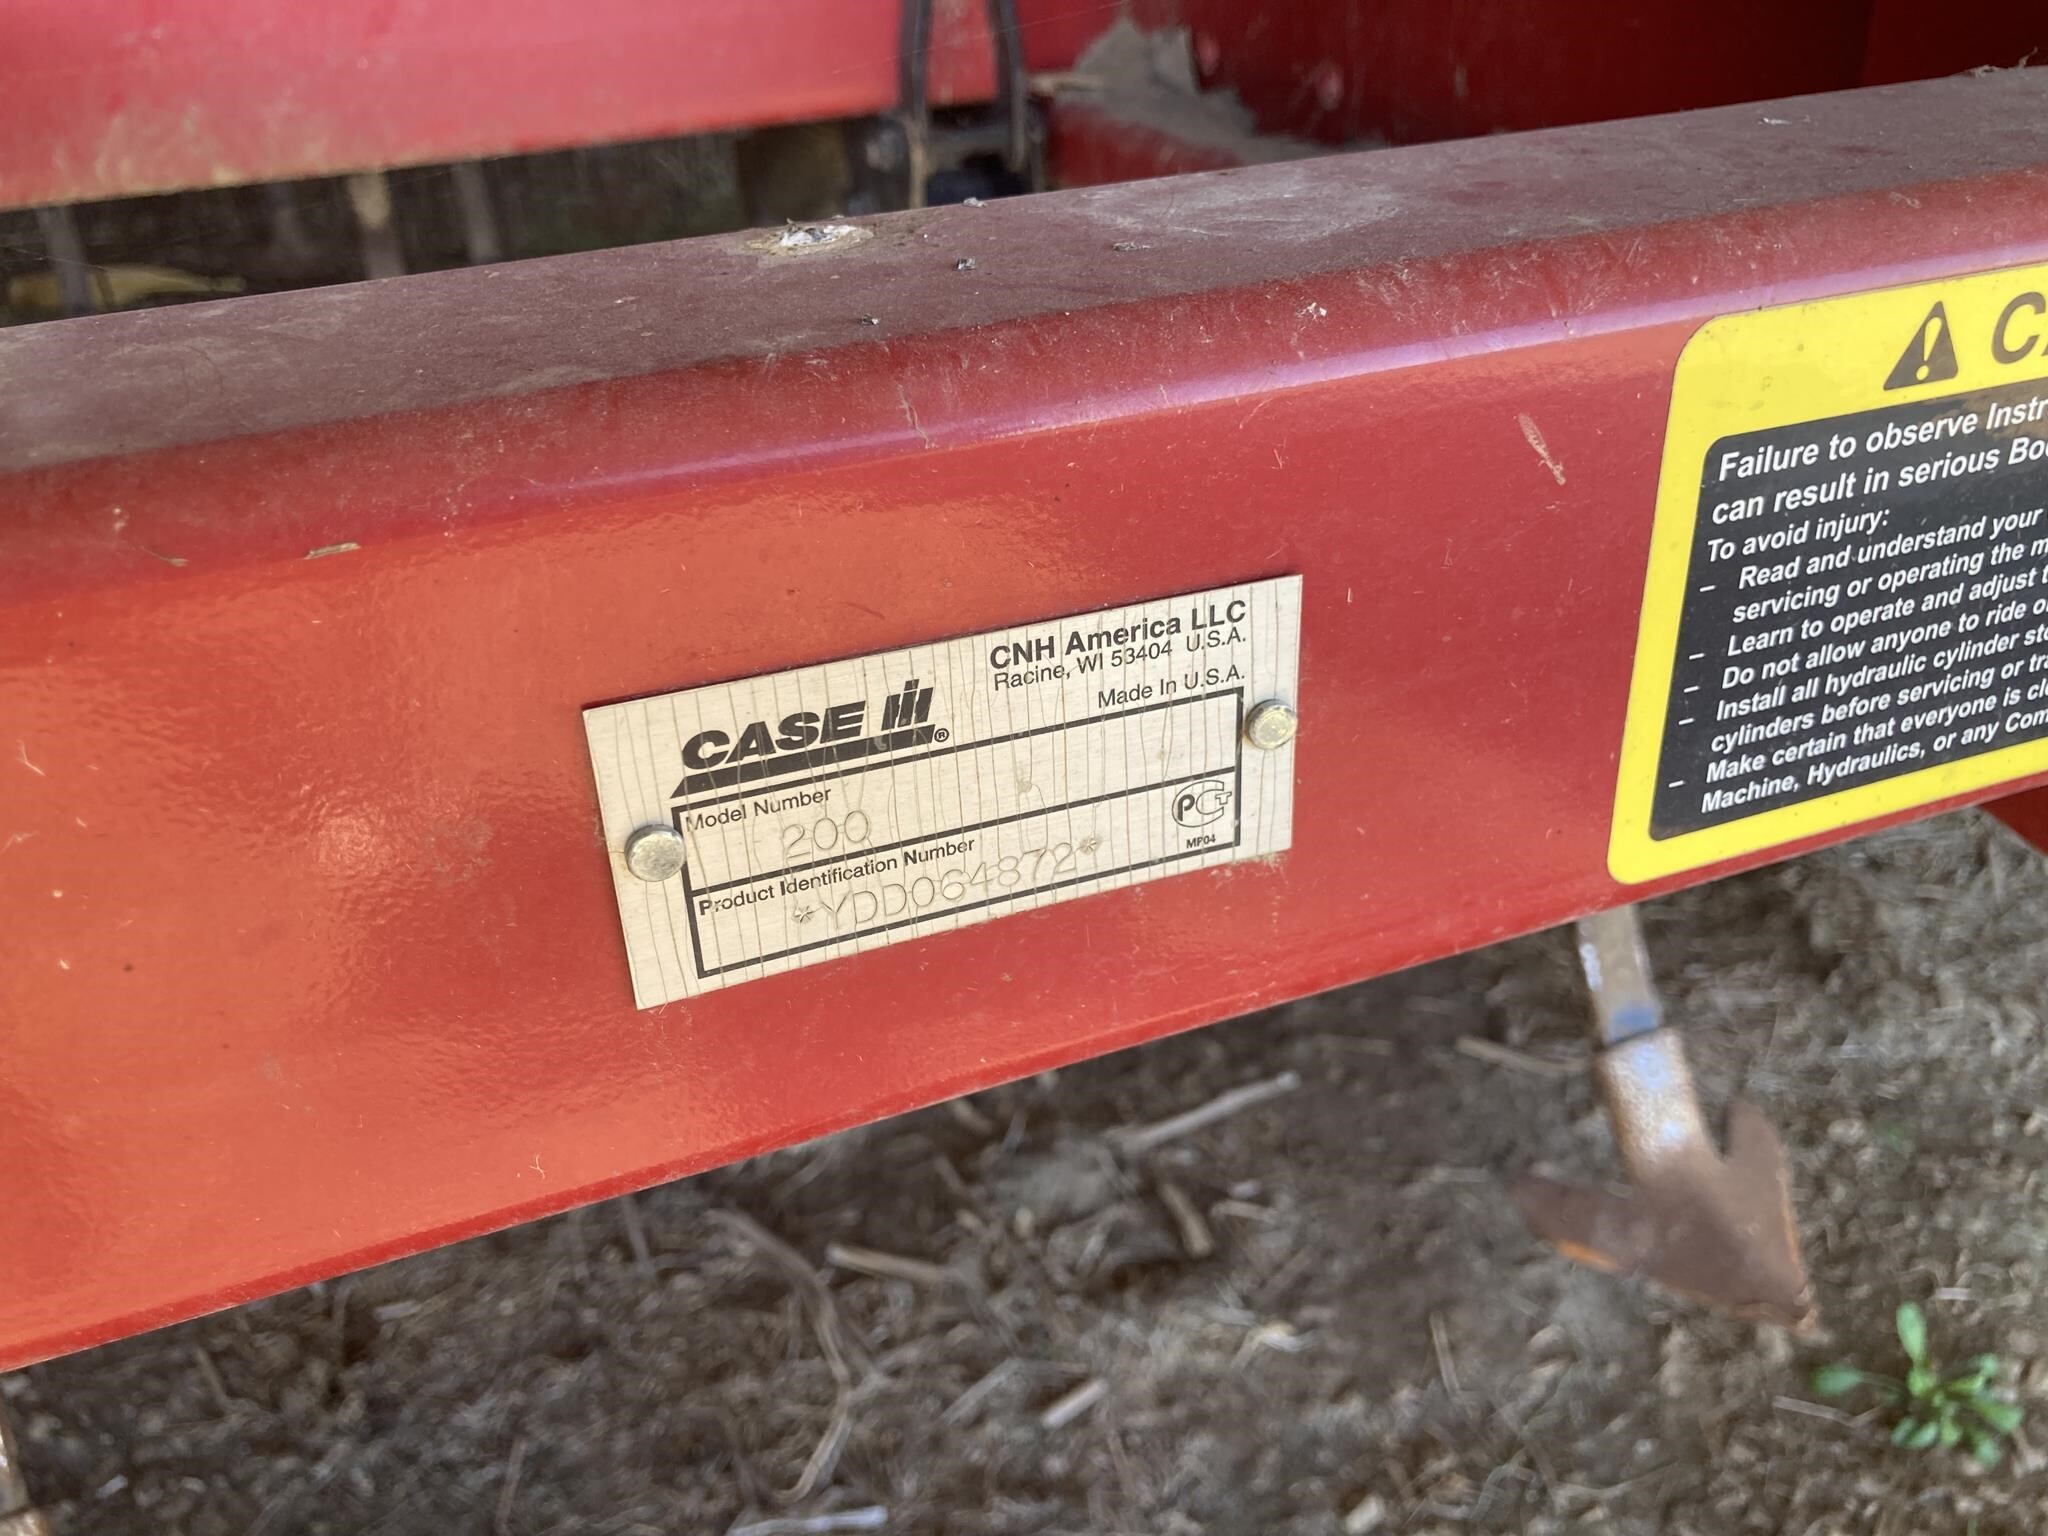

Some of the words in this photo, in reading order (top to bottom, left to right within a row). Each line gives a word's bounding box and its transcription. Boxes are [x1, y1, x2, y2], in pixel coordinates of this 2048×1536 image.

[1992, 292, 2048, 364] C
[1712, 495, 1764, 525] can
[1773, 470, 1855, 513] result
[1864, 467, 1889, 495] in
[1898, 448, 2000, 487] serious
[2008, 437, 2048, 465] Bo
[1719, 443, 1819, 481] Failure
[1828, 434, 1856, 460] to
[1866, 413, 1978, 452] observe
[1707, 538, 1735, 562] To
[1742, 520, 1810, 556] avoid
[1815, 508, 1890, 542] injury:
[1739, 555, 1801, 589] Read
[1806, 544, 1851, 575] and
[1857, 515, 1987, 563] understand
[1989, 508, 2044, 540] your
[1727, 626, 1793, 658] Learn
[1800, 618, 1823, 640] to
[1830, 597, 1915, 635] operate
[1921, 582, 1964, 612] and
[1968, 567, 2037, 601] adjust
[1732, 583, 1840, 624] servicing
[1846, 576, 1873, 598] or
[1877, 552, 1984, 593] operating
[1990, 542, 2025, 565] the
[990, 636, 1055, 670] CNH
[1065, 615, 1181, 656] America
[1192, 599, 1247, 631] LLC
[994, 664, 1071, 691] Racine,
[1077, 654, 1104, 675] WI
[1111, 640, 1173, 667] 53404
[1186, 627, 1247, 652] U.S.A.
[1721, 665, 1755, 689] Do
[1761, 652, 1801, 680] not
[1805, 640, 1866, 669] allow
[1870, 620, 1951, 653] anyone
[1958, 613, 1980, 633] to
[1985, 600, 2027, 627] ride
[2032, 598, 2048, 615] o
[1098, 680, 1153, 709] Made
[1160, 678, 1177, 695] In
[1184, 664, 1245, 690] U.S.A.
[1711, 712, 1815, 755] cylinders
[1821, 693, 1891, 725] before
[1897, 667, 1995, 705] servicing
[2001, 660, 2024, 680] or
[1716, 684, 1788, 721] Install
[1791, 676, 1820, 703] all
[1824, 653, 1927, 697] hydraulic
[1933, 633, 2020, 670] cylinder
[682, 700, 866, 770] CASE
[1701, 775, 1800, 814] Machine,
[1806, 742, 1925, 786] Hydraulics,
[1933, 732, 1957, 752] or
[1961, 721, 1999, 743] any
[1706, 753, 1767, 784] Make
[1772, 731, 1847, 766] certain
[1853, 717, 1896, 745] that
[1900, 695, 1997, 733] everyone
[2003, 686, 2021, 707] is
[2027, 678, 2048, 700] cl
[685, 804, 747, 833] Model
[754, 788, 832, 817] Number
[782, 810, 869, 859] 200
[1186, 834, 1216, 849] MP04
[698, 885, 775, 916] Product
[780, 856, 898, 897] Identification
[903, 838, 975, 866] Number
